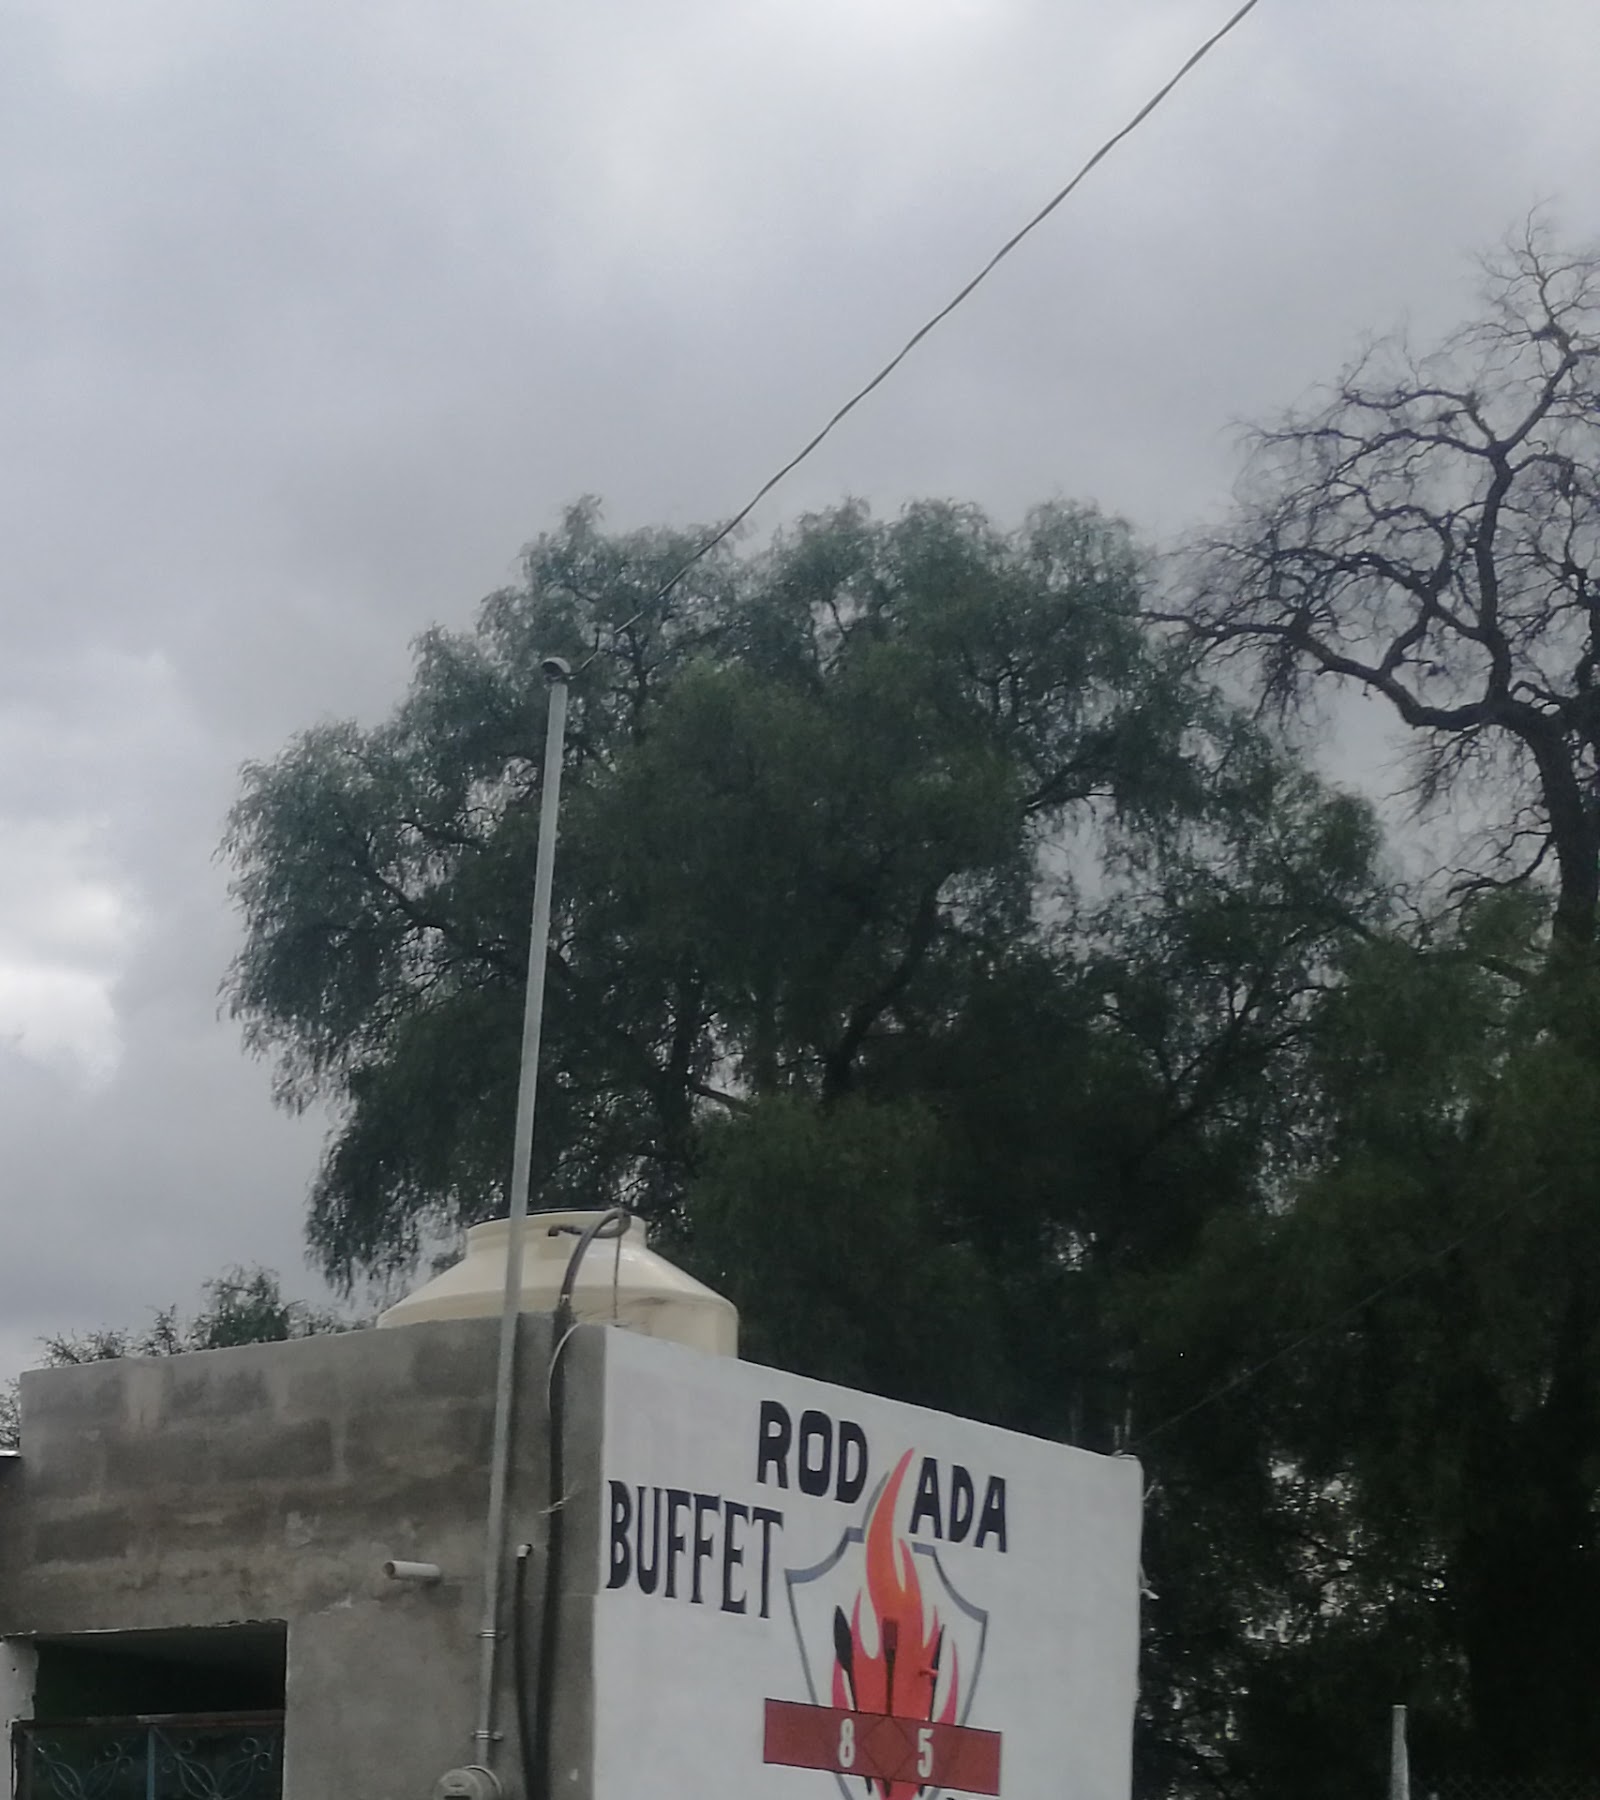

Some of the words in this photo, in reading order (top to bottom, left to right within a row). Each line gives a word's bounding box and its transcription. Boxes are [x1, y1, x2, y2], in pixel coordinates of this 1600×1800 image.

[755, 1399, 869, 1504] ROD
[908, 1456, 1008, 1553] ADA
[605, 1480, 784, 1619] BUFFET
[837, 1717, 857, 1769] 8
[916, 1727, 934, 1779] 5
